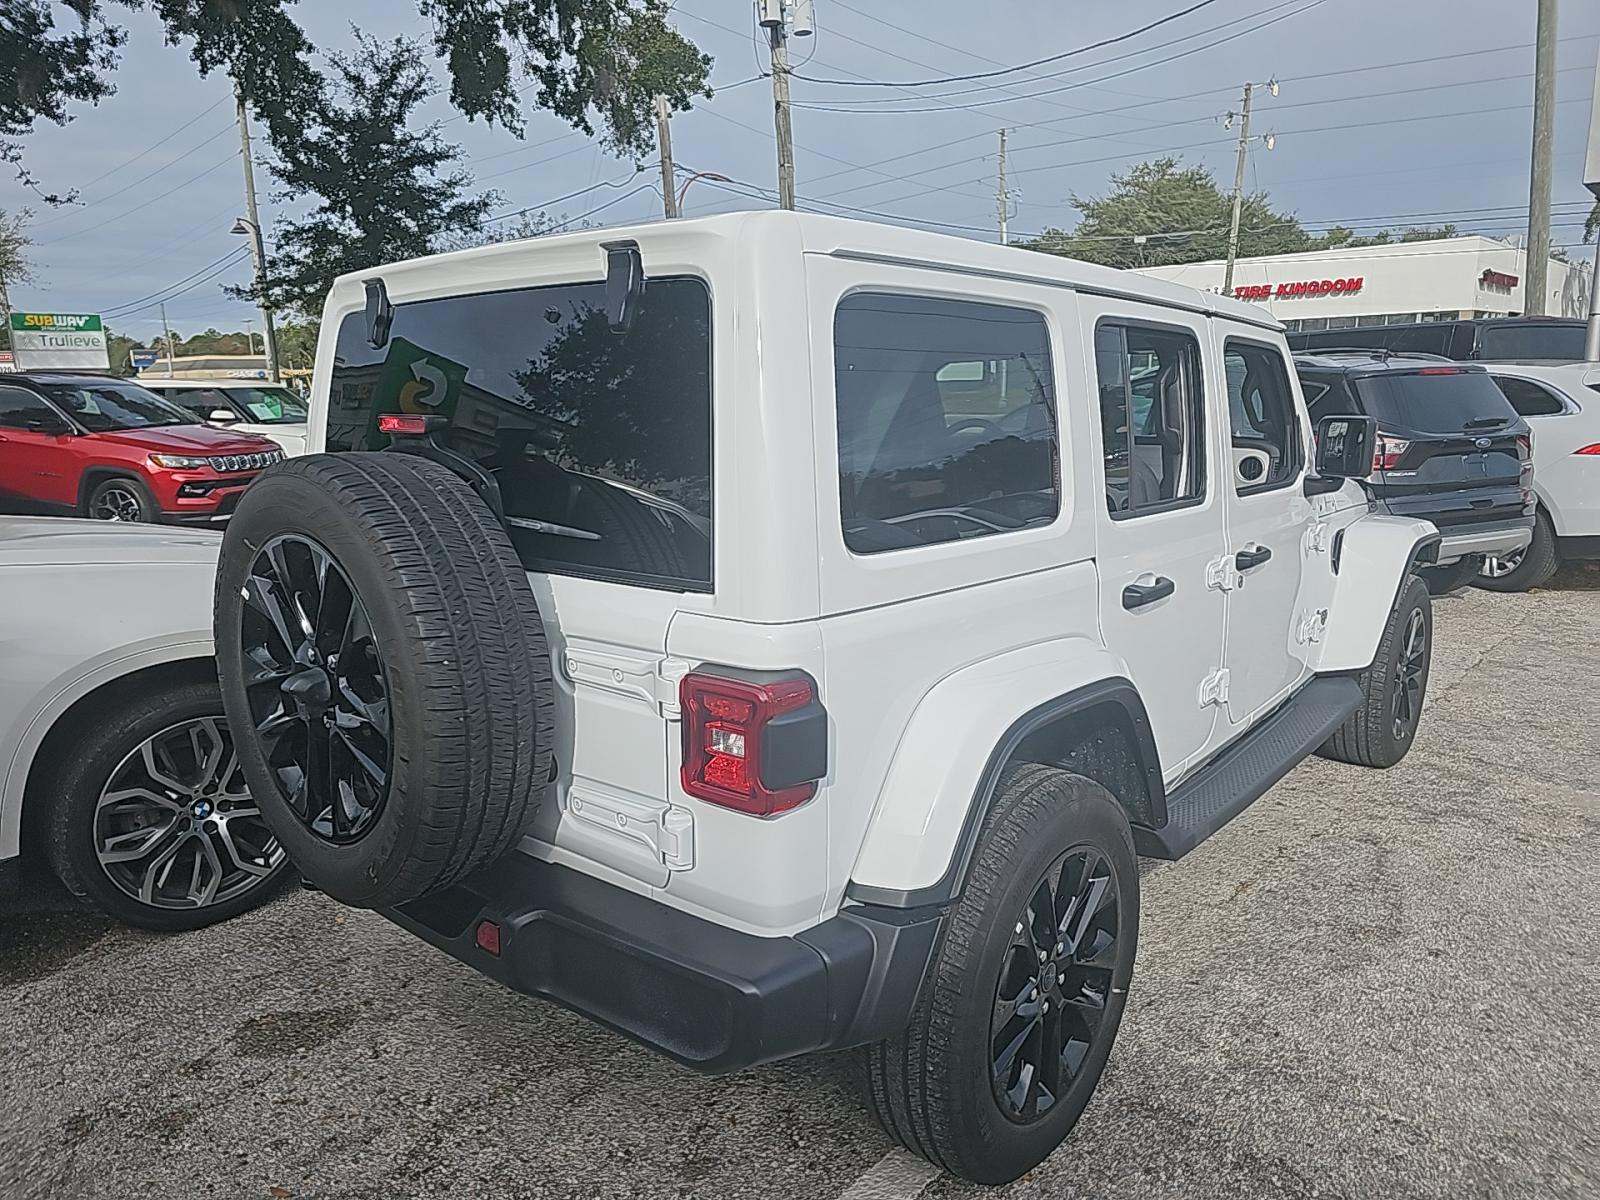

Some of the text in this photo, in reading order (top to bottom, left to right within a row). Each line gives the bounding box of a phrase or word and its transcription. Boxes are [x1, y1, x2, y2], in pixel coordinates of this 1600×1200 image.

[1234, 277, 1363, 299] TIRE KINGDOM
[24, 315, 90, 327] SUBWAY
[39, 334, 101, 347] Trulieve
